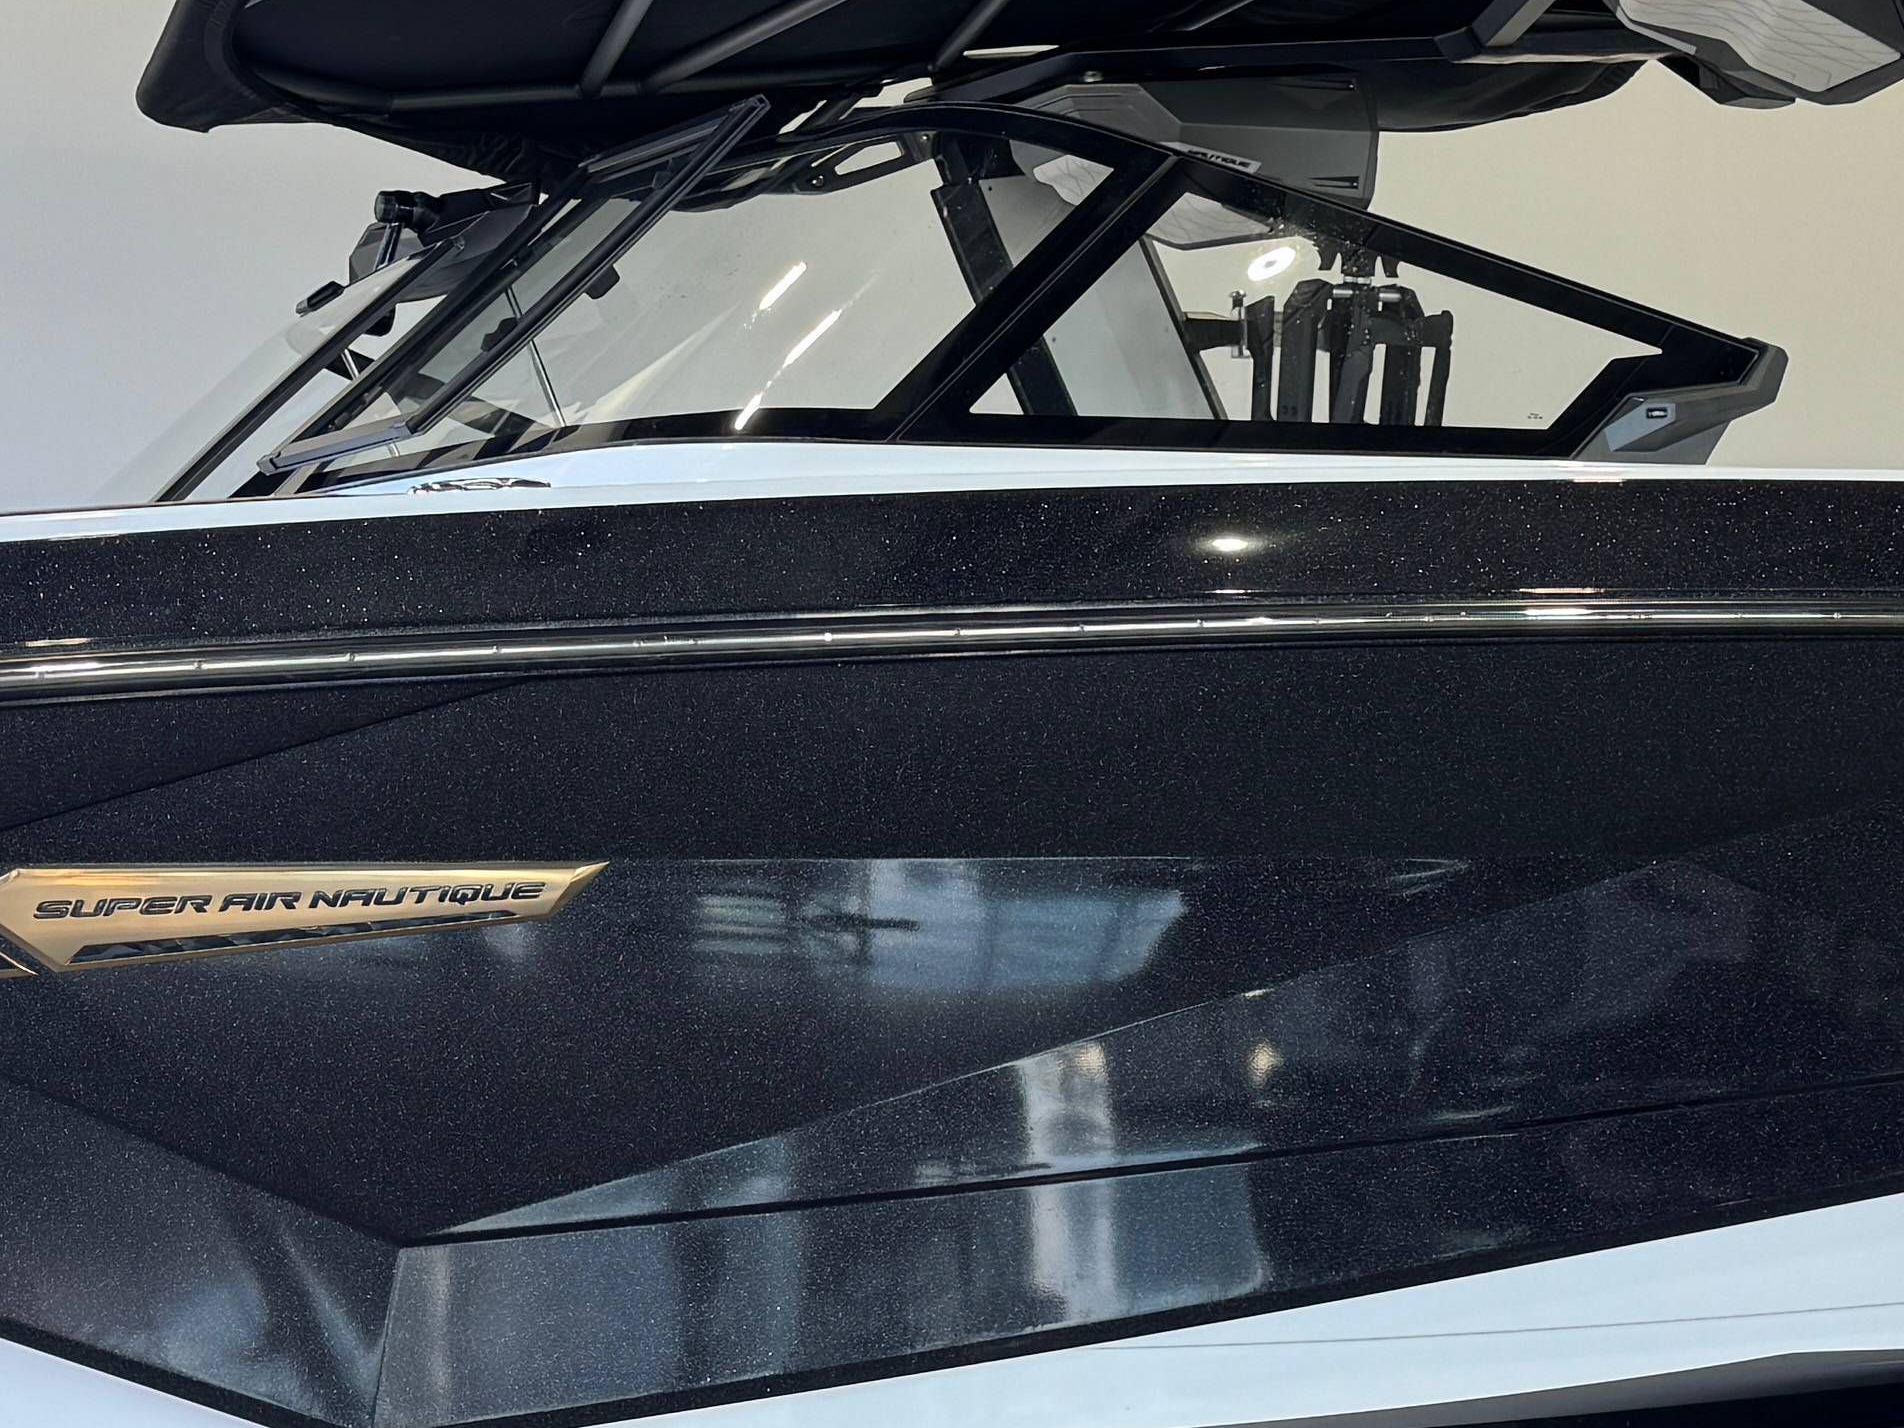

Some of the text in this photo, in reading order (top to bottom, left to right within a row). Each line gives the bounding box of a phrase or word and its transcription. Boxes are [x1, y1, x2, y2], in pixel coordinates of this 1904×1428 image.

[33, 880, 548, 921] SUPER AIR NAUTIQUE
